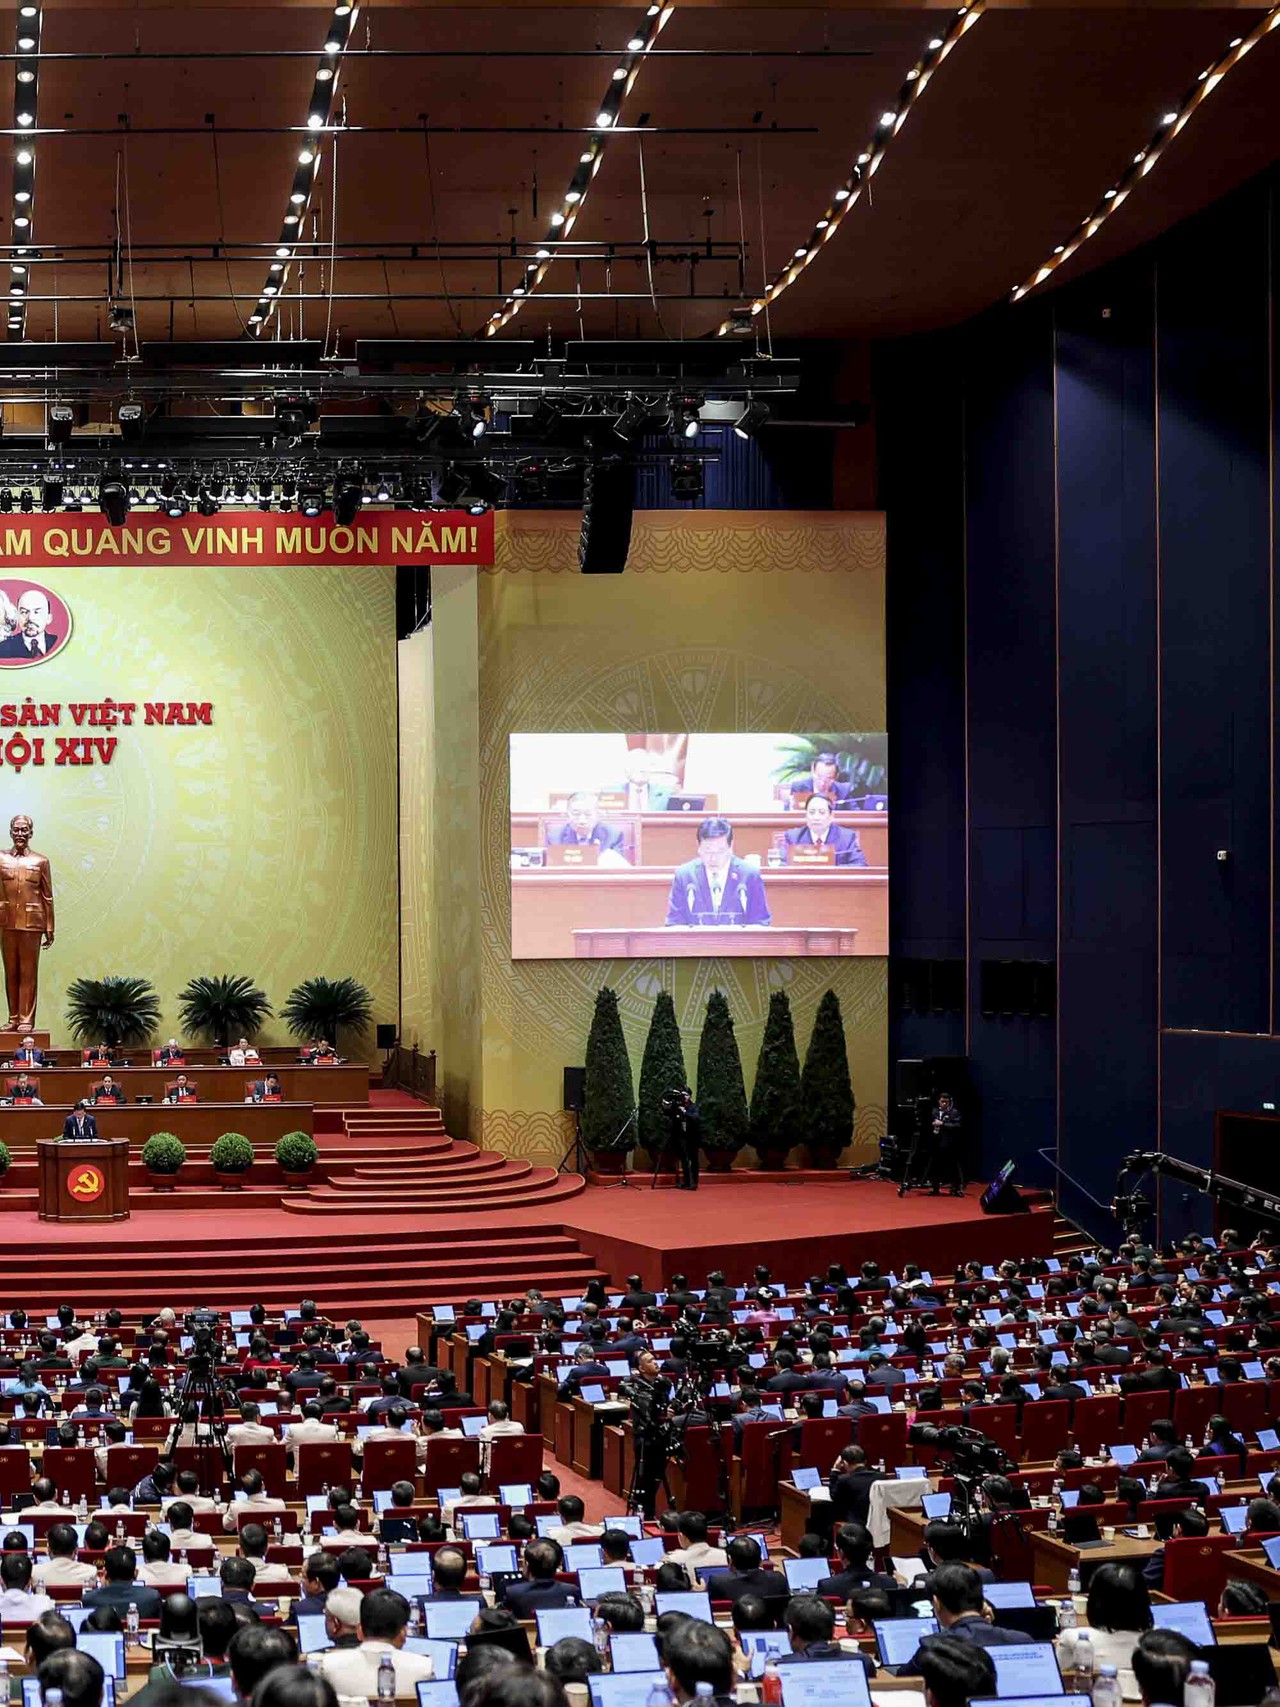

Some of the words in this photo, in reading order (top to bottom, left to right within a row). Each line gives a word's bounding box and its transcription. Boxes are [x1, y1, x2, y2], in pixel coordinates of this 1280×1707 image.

[43, 528, 171, 557] QUANG
[181, 526, 264, 554] VINH
[391, 520, 477, 553] NĂM!
[0, 697, 62, 727] SẢN
[69, 697, 137, 732] VIỆT
[143, 702, 214, 725] NAM
[55, 736, 119, 766] XIV
